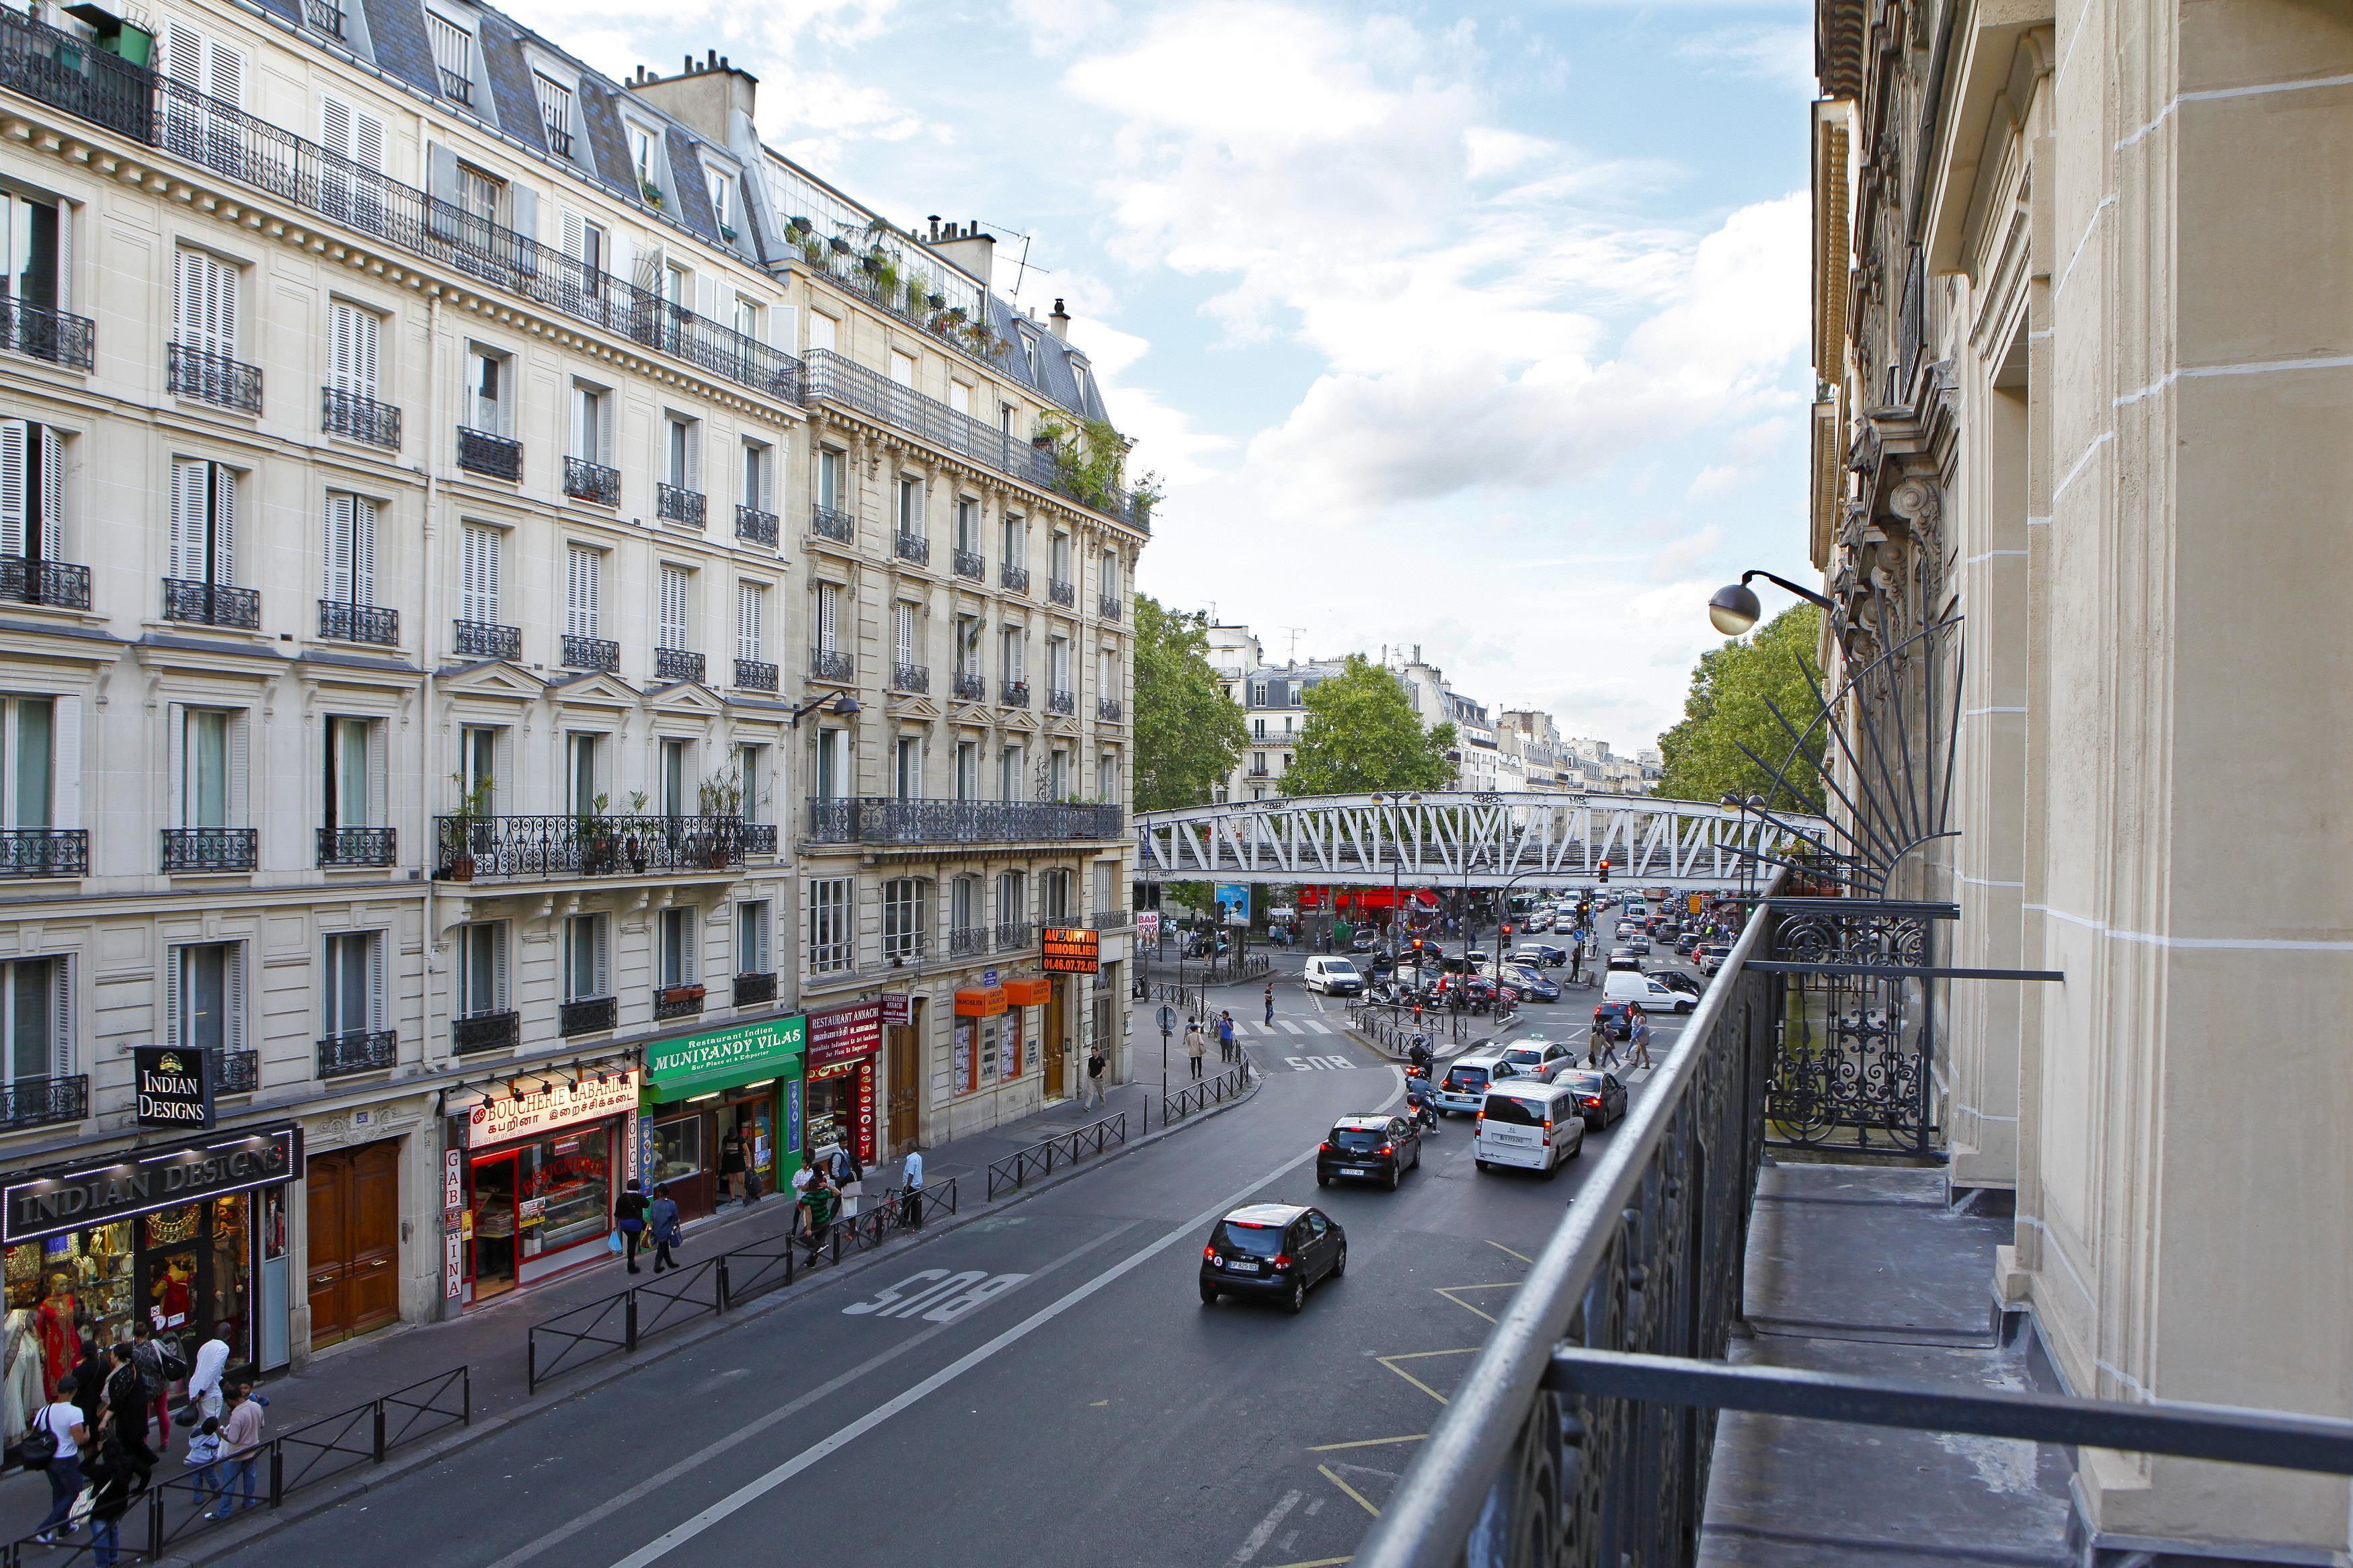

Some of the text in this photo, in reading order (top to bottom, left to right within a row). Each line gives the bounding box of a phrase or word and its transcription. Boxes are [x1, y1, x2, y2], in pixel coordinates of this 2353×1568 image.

[1138, 915, 1157, 923] BAD
[1044, 943, 1098, 956] IMMOBILIER
[1044, 958, 1097, 972] 01.46.07.72.05
[990, 989, 1004, 998] GROUPE
[812, 1007, 879, 1029] RESTAURANT ANNACHI
[688, 1027, 773, 1048] Restaurant Indien
[654, 1029, 801, 1071] MUNIYANDY VILAS
[707, 1059, 724, 1067] Place
[740, 1050, 770, 1060] Emporter
[1284, 1055, 1358, 1071] BUS
[143, 1070, 198, 1094] INDIAN
[138, 1094, 204, 1120] DESIGNS
[487, 1089, 565, 1121] BOUCHERIE
[474, 1110, 485, 1123] BG
[19, 1145, 283, 1226] INDIAN DESIGNS
[448, 1153, 459, 1295] GABINA
[842, 1269, 1031, 1321] BUS
